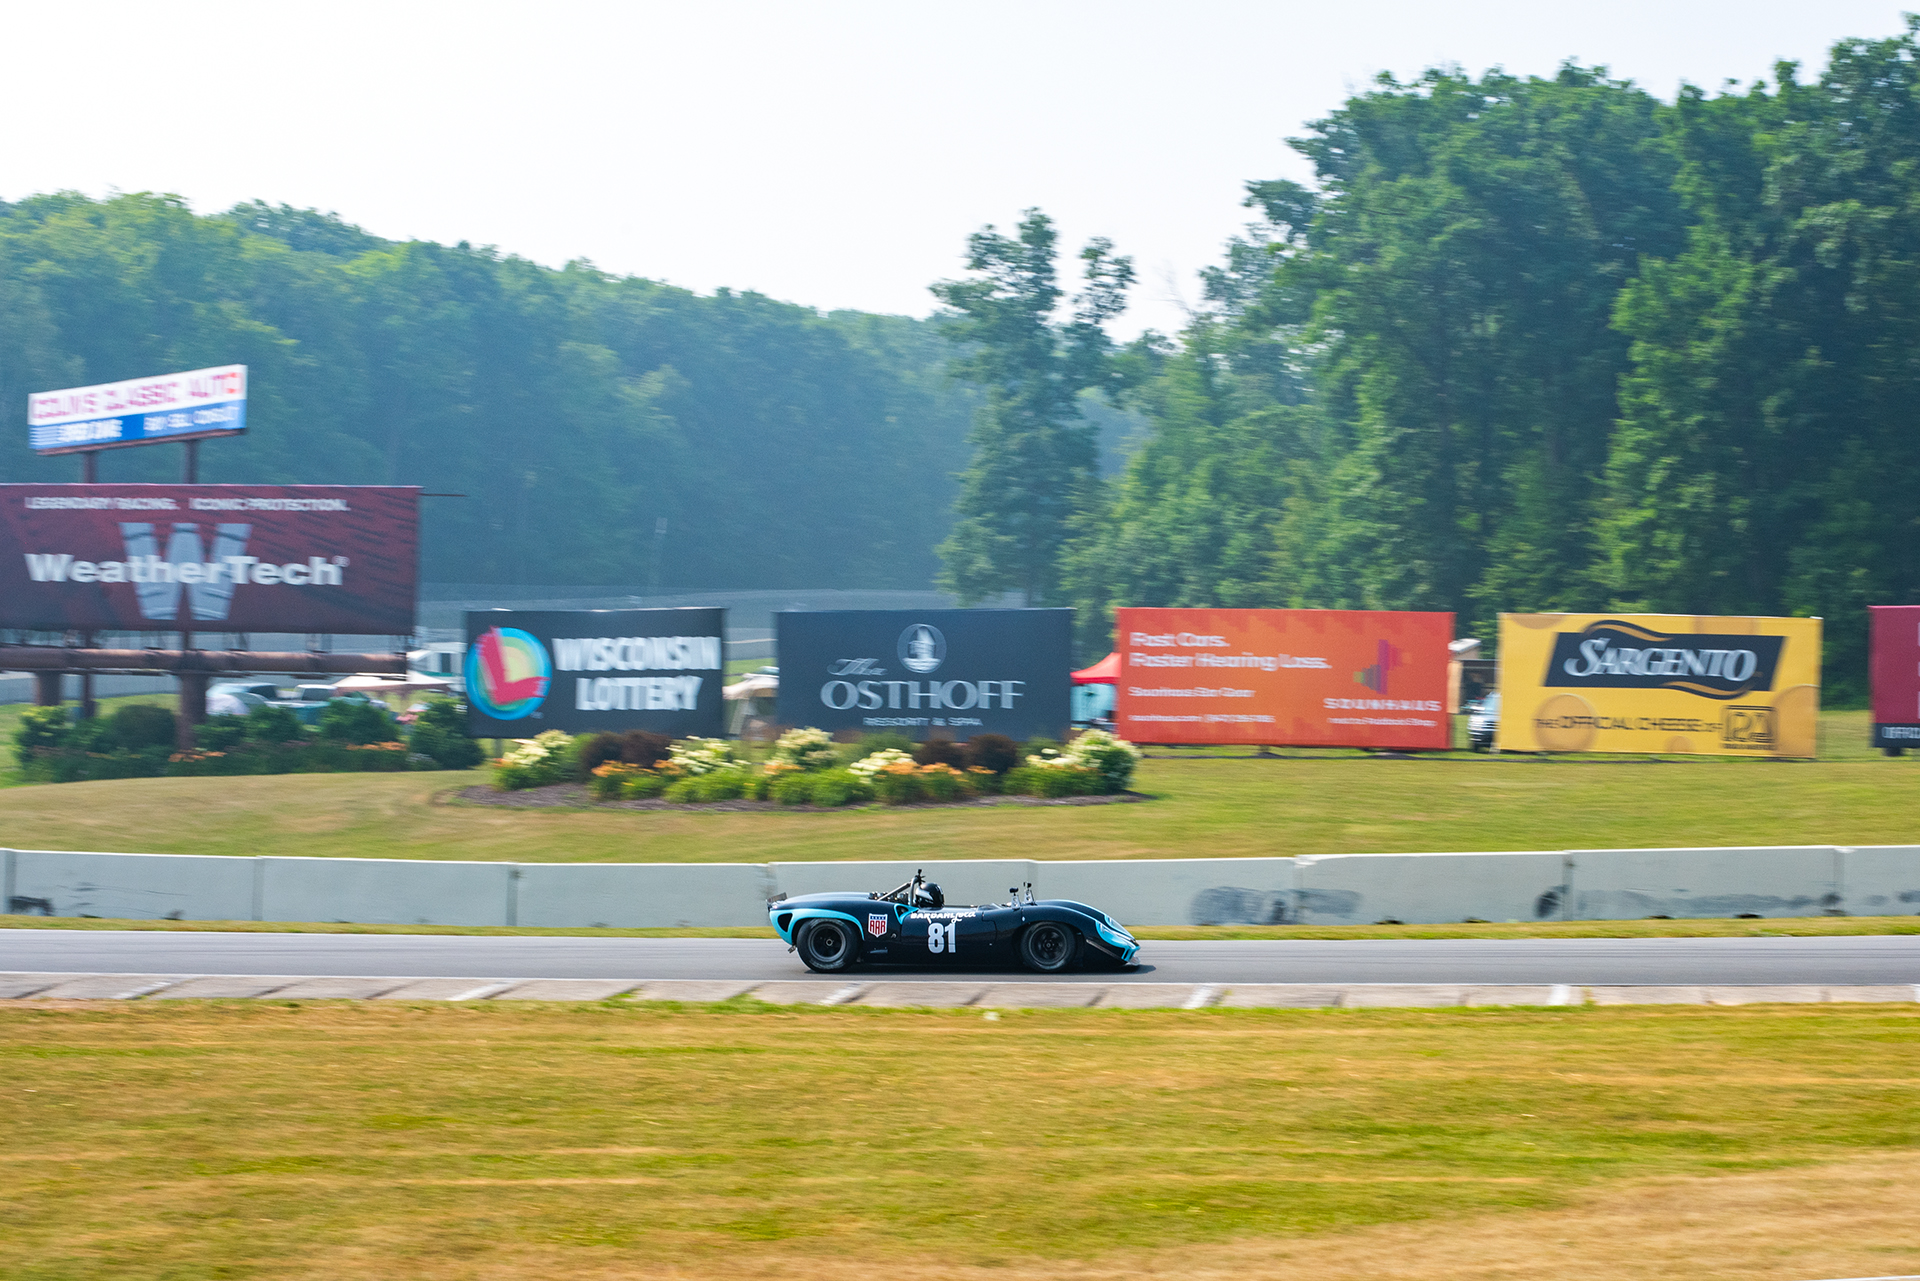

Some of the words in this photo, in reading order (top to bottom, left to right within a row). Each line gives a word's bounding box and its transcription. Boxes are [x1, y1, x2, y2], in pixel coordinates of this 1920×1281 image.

[24, 553, 344, 585] WeatherTech
[1129, 632, 1177, 647] Fast
[1176, 632, 1231, 647] Cars.
[551, 636, 722, 671] WISCONSIN
[1129, 652, 1194, 667] Faster
[1194, 651, 1279, 671] Hearing
[1278, 653, 1333, 669] Loss.
[1563, 637, 1758, 682] SARGENTO
[826, 657, 888, 676] The
[575, 675, 704, 711] LOTTERY
[820, 680, 1026, 710] OSTHOFF
[1323, 697, 1442, 711] SOUNHAUS
[862, 717, 930, 727] RESORT
[930, 717, 947, 727] &
[947, 717, 984, 727] SPA
[1559, 715, 1633, 731] OFFICIAL
[1634, 717, 1702, 732] CHEESE
[869, 920, 887, 934] AAR
[910, 912, 955, 924] BARDAHL
[927, 922, 956, 954] 81
